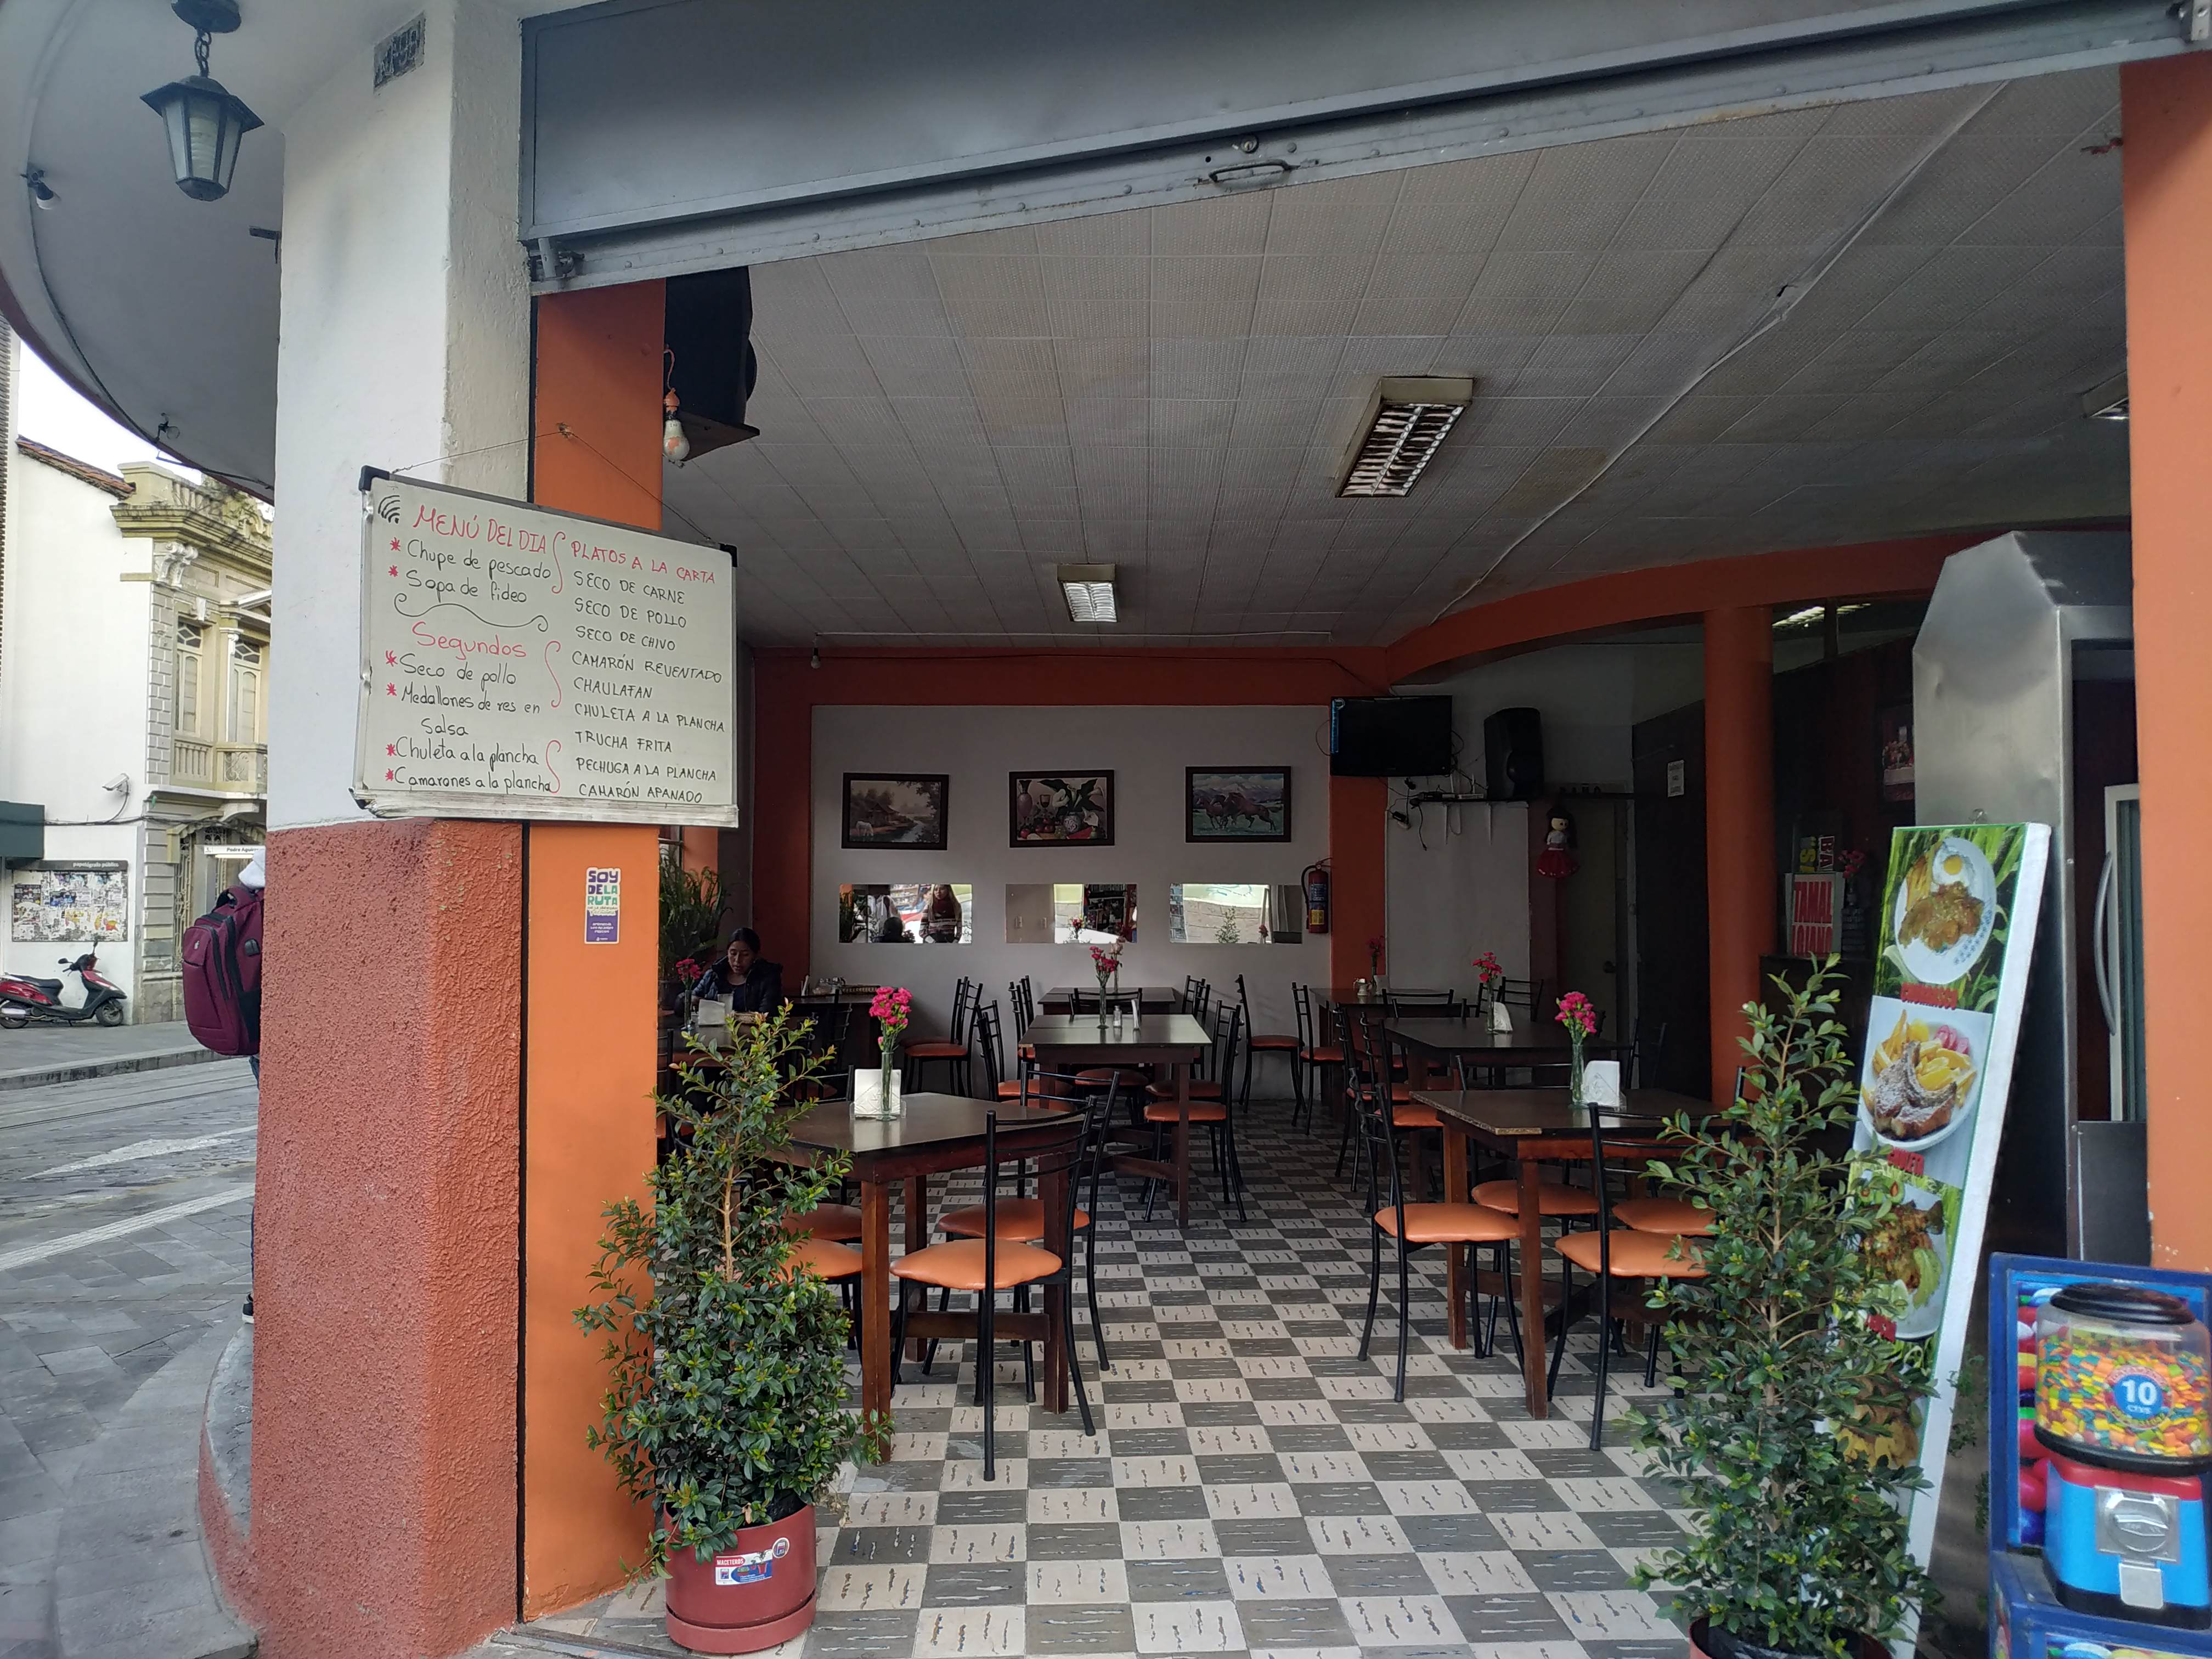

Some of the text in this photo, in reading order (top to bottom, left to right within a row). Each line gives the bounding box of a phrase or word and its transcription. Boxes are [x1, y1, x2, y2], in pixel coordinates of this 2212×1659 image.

[413, 505, 546, 554] MENÚ DEL DIA
[408, 539, 551, 580] Chupe de pescado
[571, 540, 715, 584] PLATOS A LA CARTA
[406, 570, 527, 602] Sopa de fideo
[574, 571, 685, 605] SECO DE CARNE
[574, 597, 686, 628] SECO DE POLLO
[412, 621, 527, 661] Segundos
[575, 625, 676, 651] SECO DE CHIVO
[399, 653, 516, 692] Seco de pollo
[572, 651, 634, 670] CAMARÓN
[401, 681, 540, 713] Medallones de res en
[574, 677, 652, 699] CHAULAFAN
[421, 714, 469, 735] Salsa
[575, 703, 724, 732] CHULETA A LA PLANCHA
[396, 736, 539, 772] Chuleta a la plancha
[575, 730, 672, 753] TRUCHA FRITA
[394, 766, 551, 794] Camarones a la plancha
[576, 757, 716, 781] PECHUGA A LA PLANCHA
[579, 781, 702, 803] CAMARÓN APANADO
[588, 870, 618, 883] SOY
[588, 884, 618, 895] DE LA
[588, 896, 618, 905] RUTA
[2121, 1379, 2157, 1406] 10
